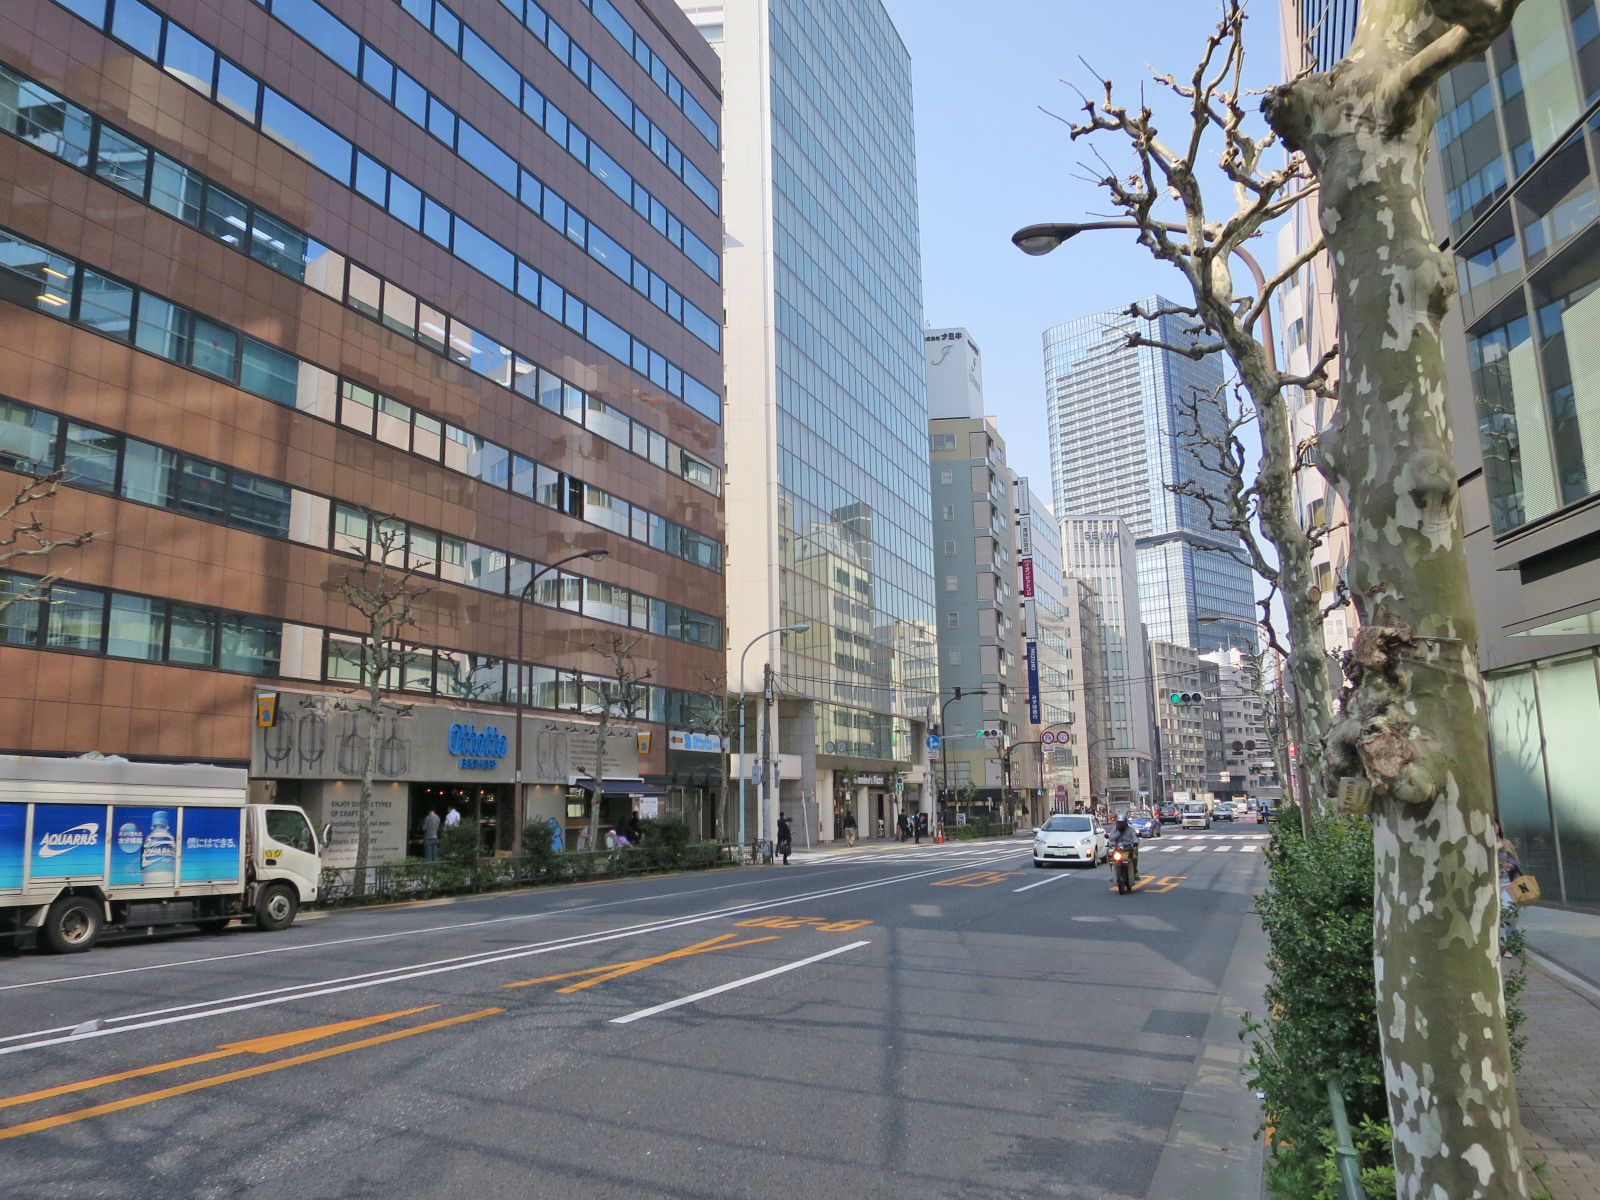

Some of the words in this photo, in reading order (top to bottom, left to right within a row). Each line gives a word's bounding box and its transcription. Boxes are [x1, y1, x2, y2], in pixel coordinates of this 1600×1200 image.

[925, 331, 963, 342] 式会社ナミキ
[1084, 531, 1119, 540] SEIWA
[449, 723, 508, 758] Ottotto
[39, 832, 99, 847] AQUARIUS
